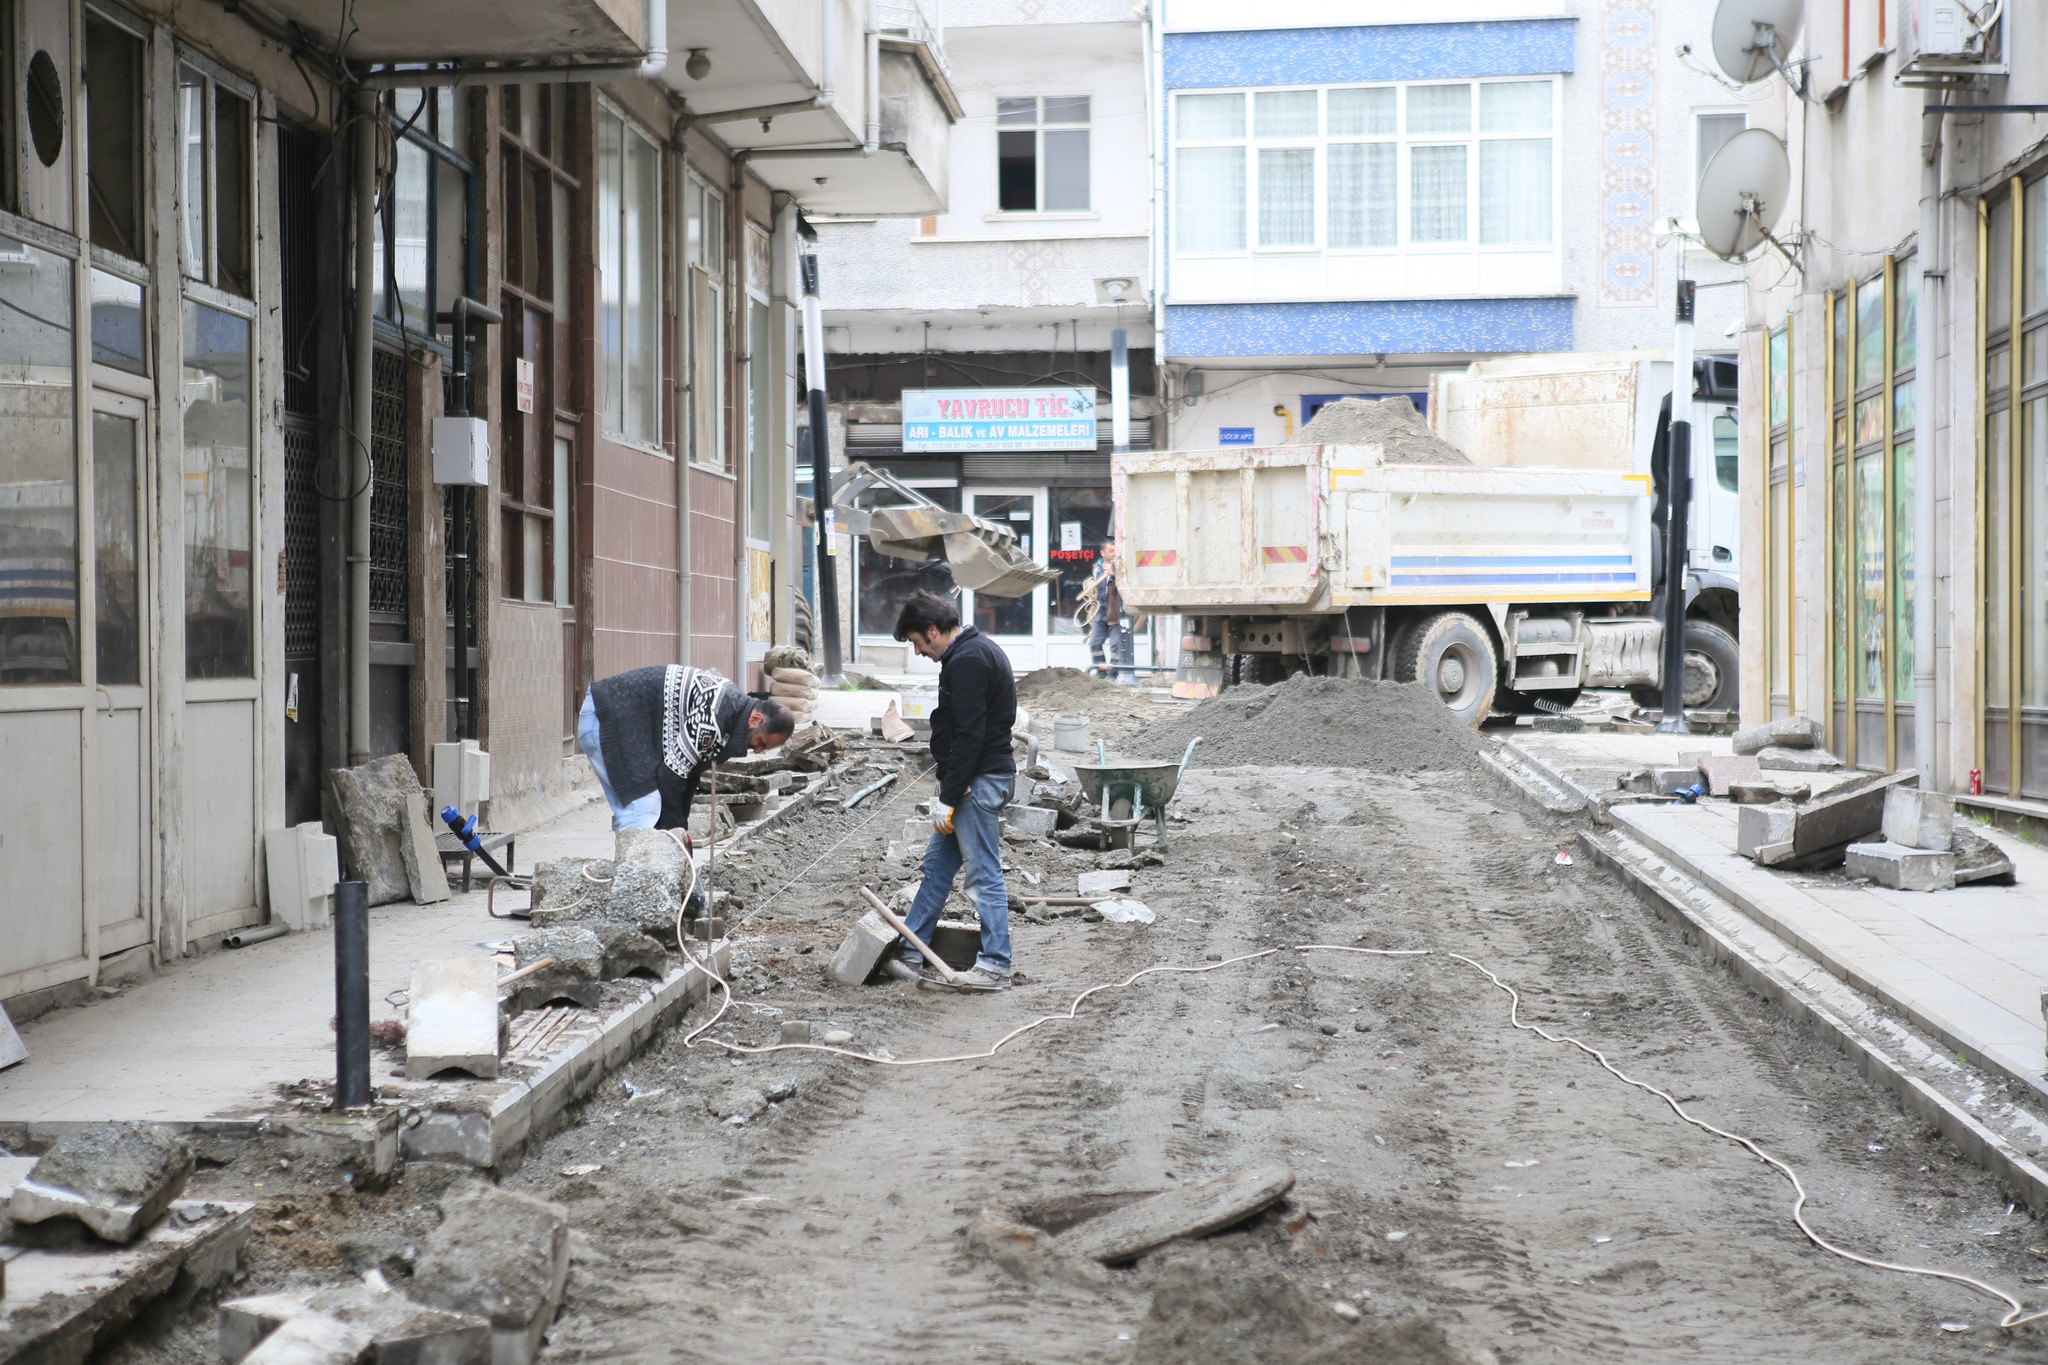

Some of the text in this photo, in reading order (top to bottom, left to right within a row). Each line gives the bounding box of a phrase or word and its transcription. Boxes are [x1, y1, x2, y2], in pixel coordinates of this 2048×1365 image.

[937, 398, 1030, 419] YAVRUCU
[909, 426, 929, 439] ARI
[938, 425, 973, 439] BALIK
[989, 425, 1005, 438] AV
[1008, 420, 1090, 438] MALZEMELERİ
